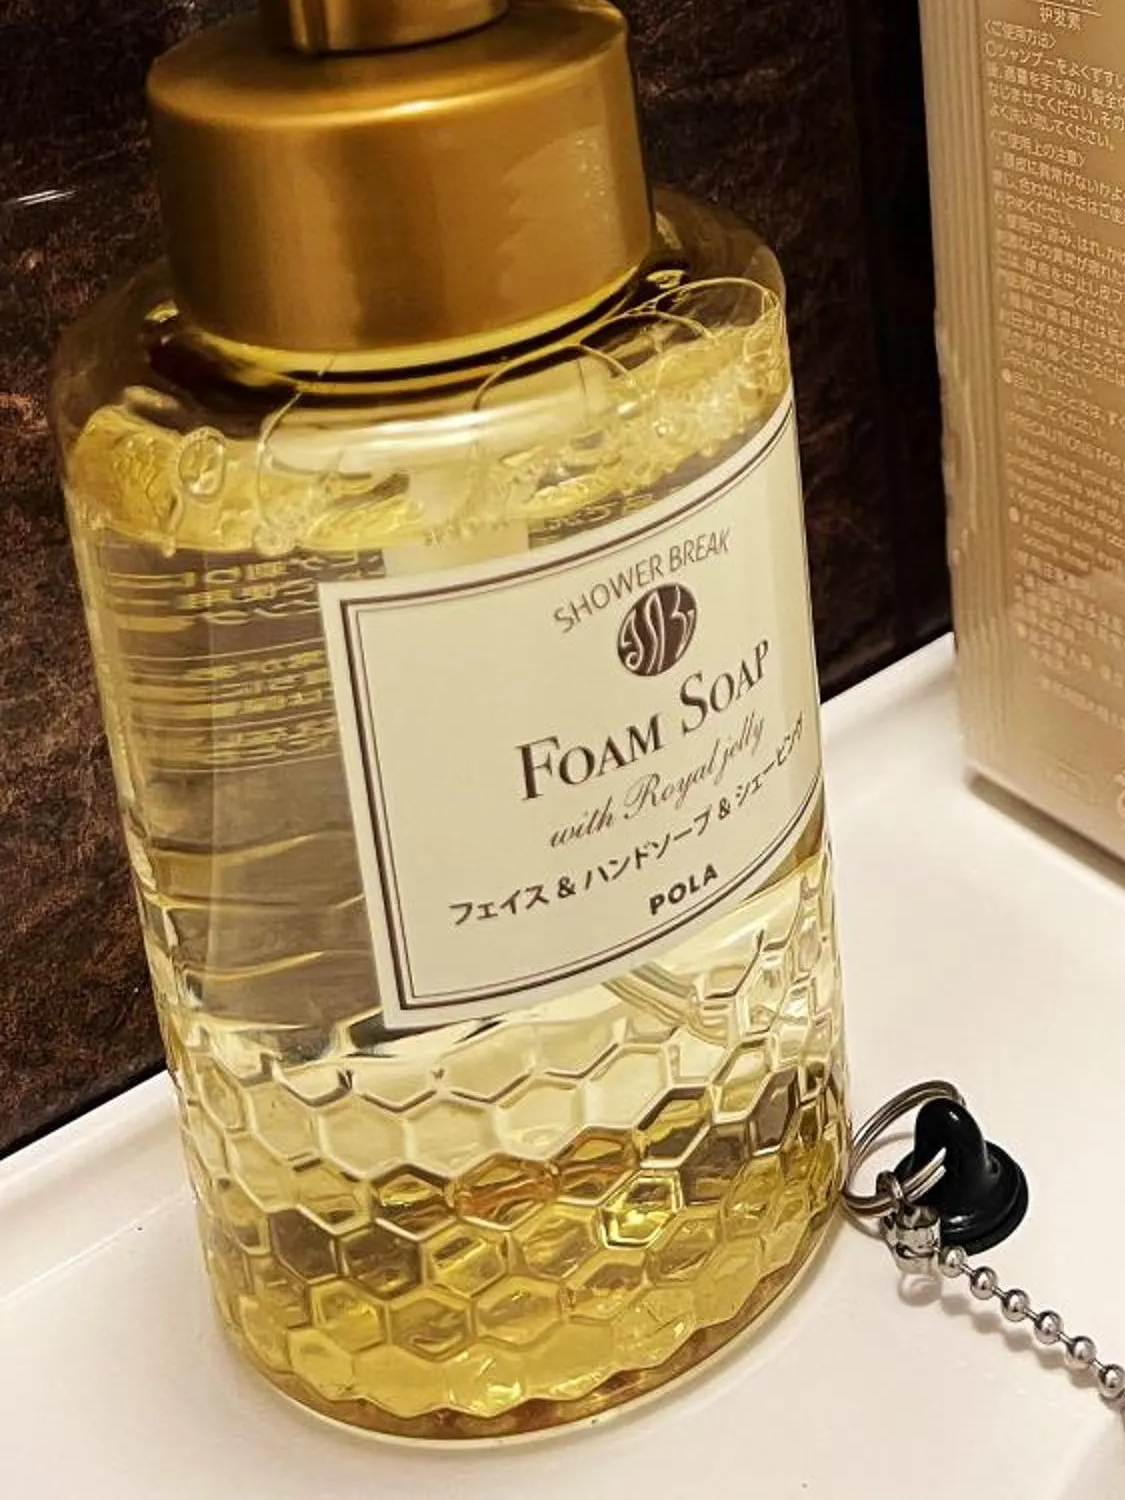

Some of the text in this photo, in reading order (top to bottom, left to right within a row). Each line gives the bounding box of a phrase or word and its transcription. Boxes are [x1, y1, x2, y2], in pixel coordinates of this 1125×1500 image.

[554, 526, 731, 633] SHOWER BREAK
[515, 639, 769, 800] FOAM SOAP
[549, 709, 764, 848] with Royal jelly
[650, 863, 719, 915] POLA
